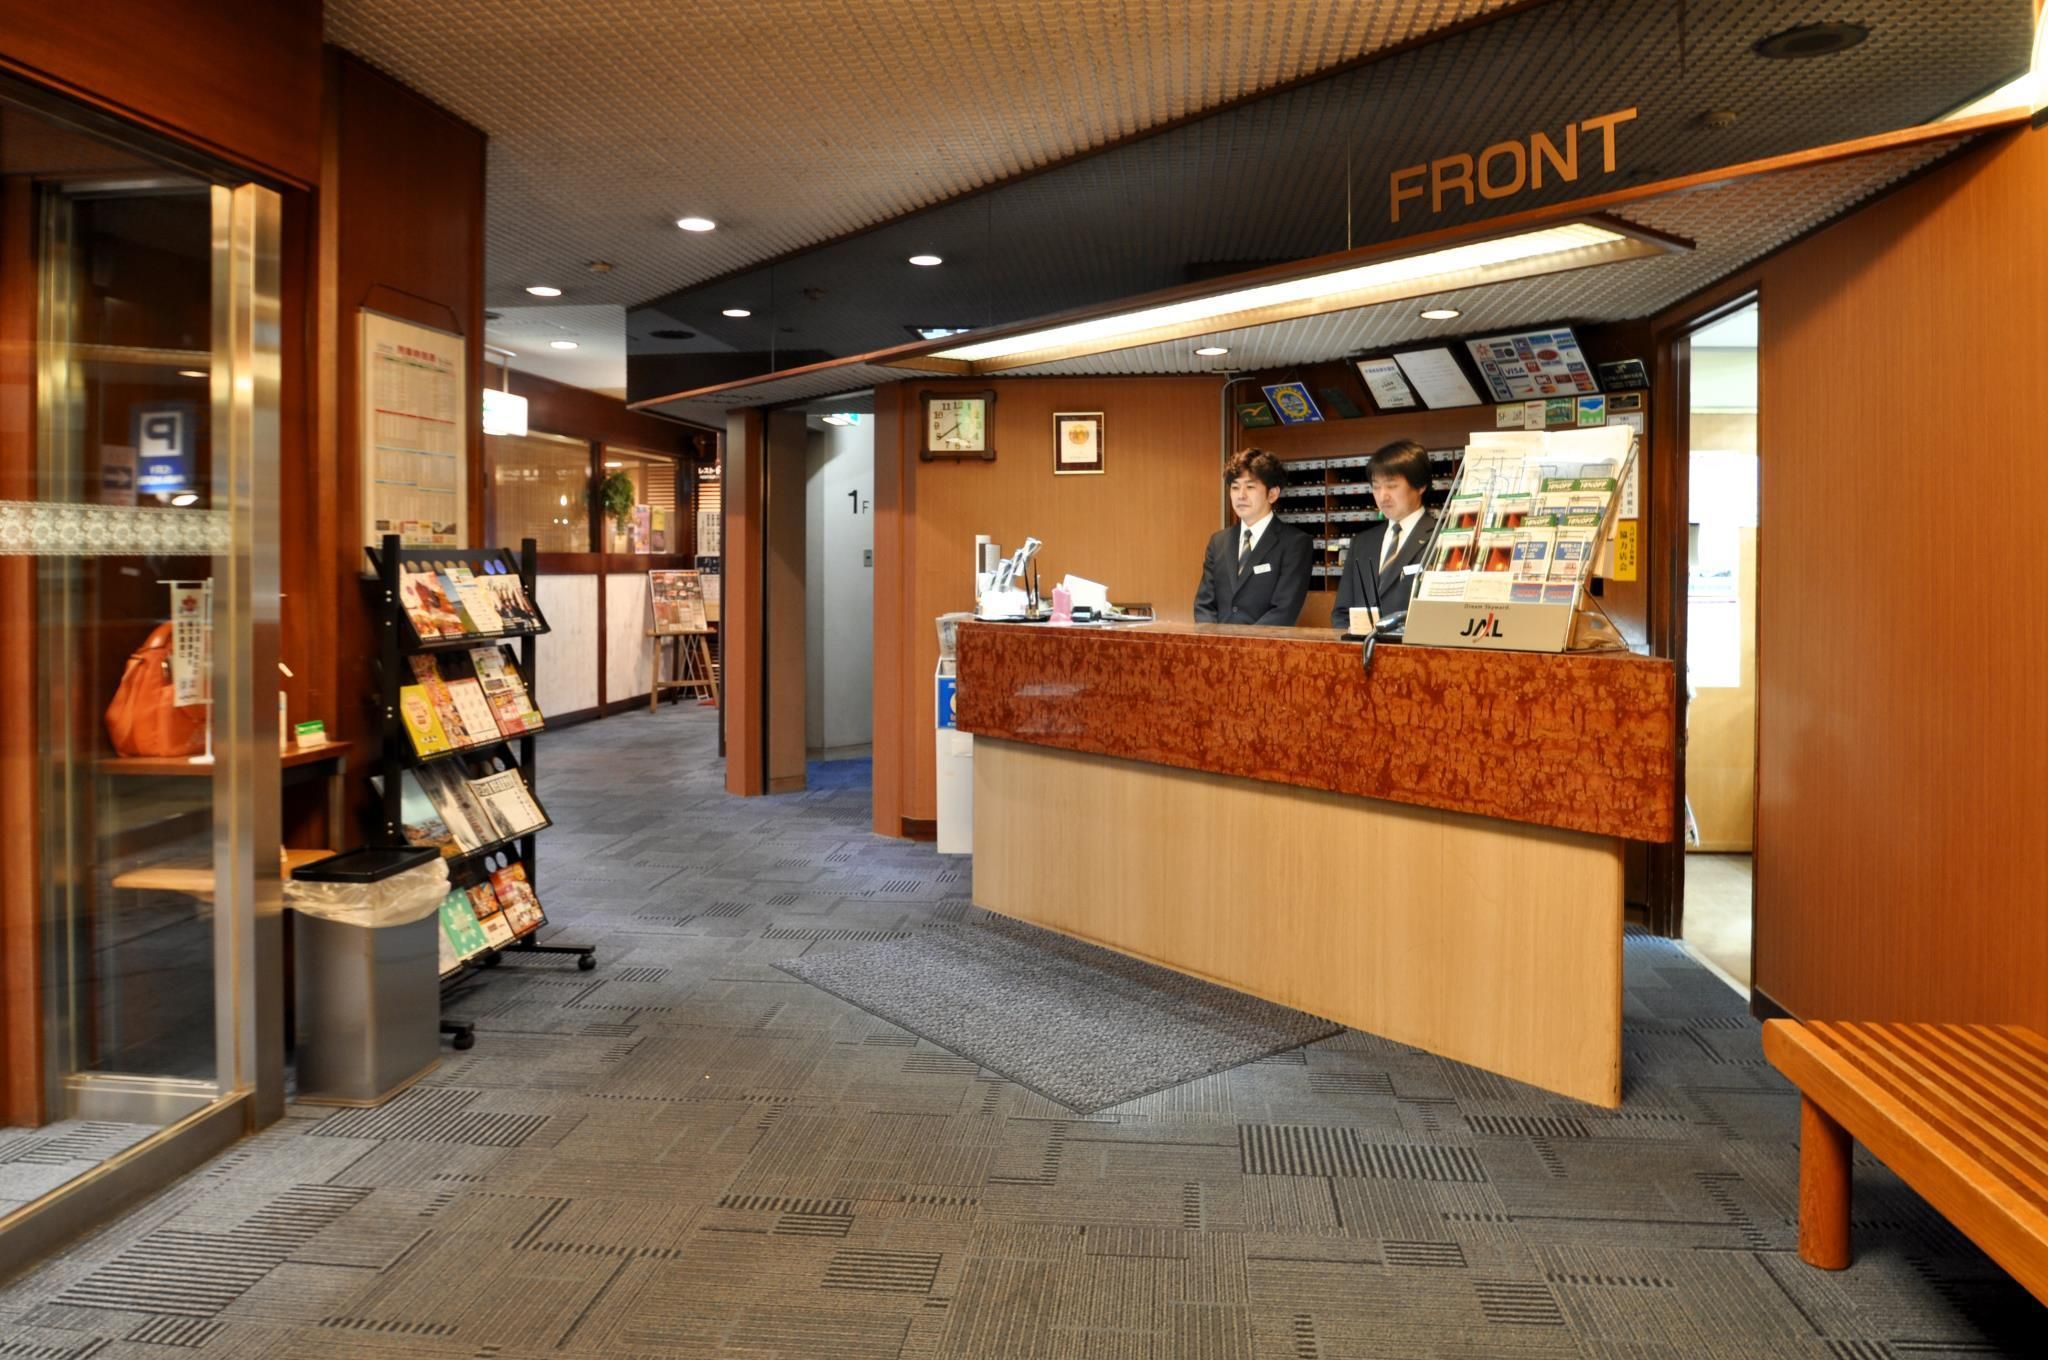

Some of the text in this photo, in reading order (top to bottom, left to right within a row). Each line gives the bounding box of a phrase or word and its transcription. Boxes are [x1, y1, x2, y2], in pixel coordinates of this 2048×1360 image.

[1389, 107, 1639, 224] FRONT
[1505, 367, 1525, 375] VISA
[847, 489, 870, 514] 1F
[1460, 615, 1503, 640] JAL
